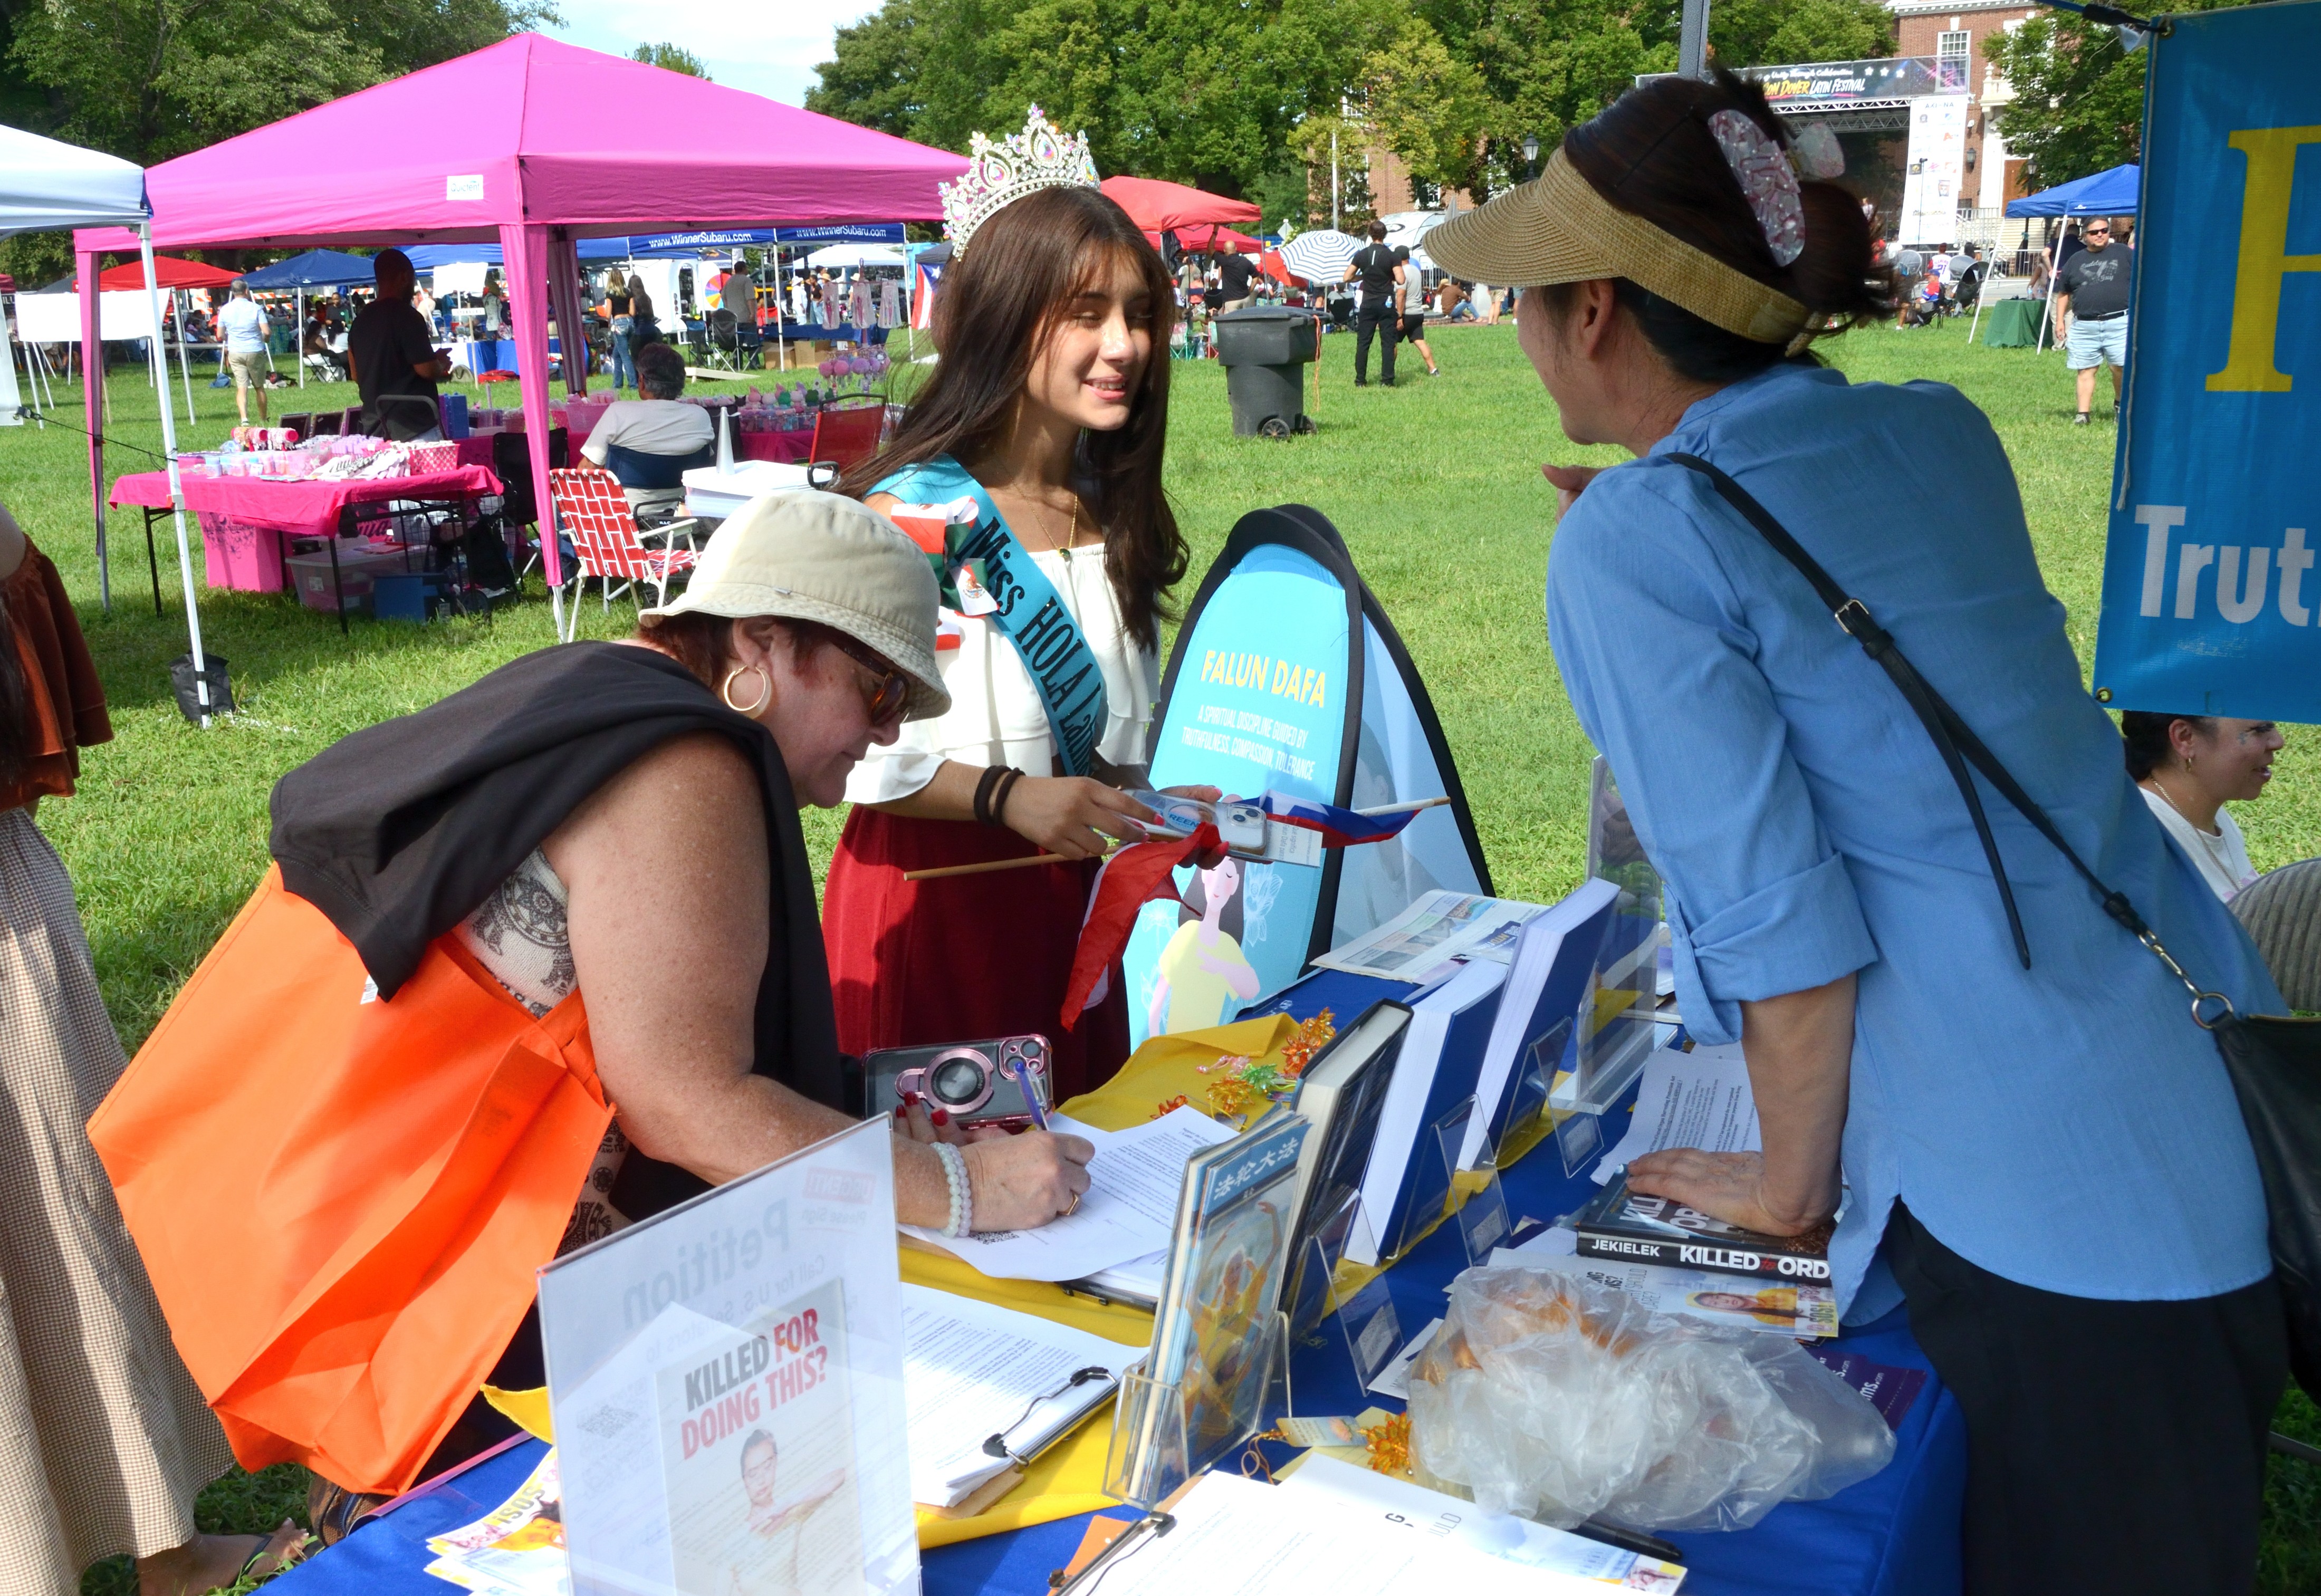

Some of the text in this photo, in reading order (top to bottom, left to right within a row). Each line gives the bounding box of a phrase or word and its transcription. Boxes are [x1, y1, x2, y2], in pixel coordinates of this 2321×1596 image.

[1780, 80, 1810, 96] DOVER
[1809, 80, 1832, 95] LATIN
[1831, 78, 1866, 93] FESTIVAL
[649, 232, 752, 248] www.WinnerSubaru.com
[797, 226, 886, 238] www.WinnerSubaru.com
[2134, 505, 2321, 627] Trut
[1015, 596, 1092, 710] HOLA
[1200, 649, 1326, 708] FALUN DAFA
[1198, 705, 1308, 749] A SPIRITUAL DISCIPLINE GUIDED BY
[1181, 726, 1315, 781] TRUTHFULNESS, COMPASSION, TOLERANCE
[1169, 814, 1200, 827] REEN
[1592, 1239, 1660, 1257] JEKIELEK
[1680, 1245, 1760, 1270] KILLED
[1778, 1258, 1830, 1279] ORD
[684, 1335, 770, 1411] KILLED
[774, 1308, 819, 1364] FOR
[681, 1383, 760, 1460] DOING
[765, 1345, 827, 1411] THIS?
